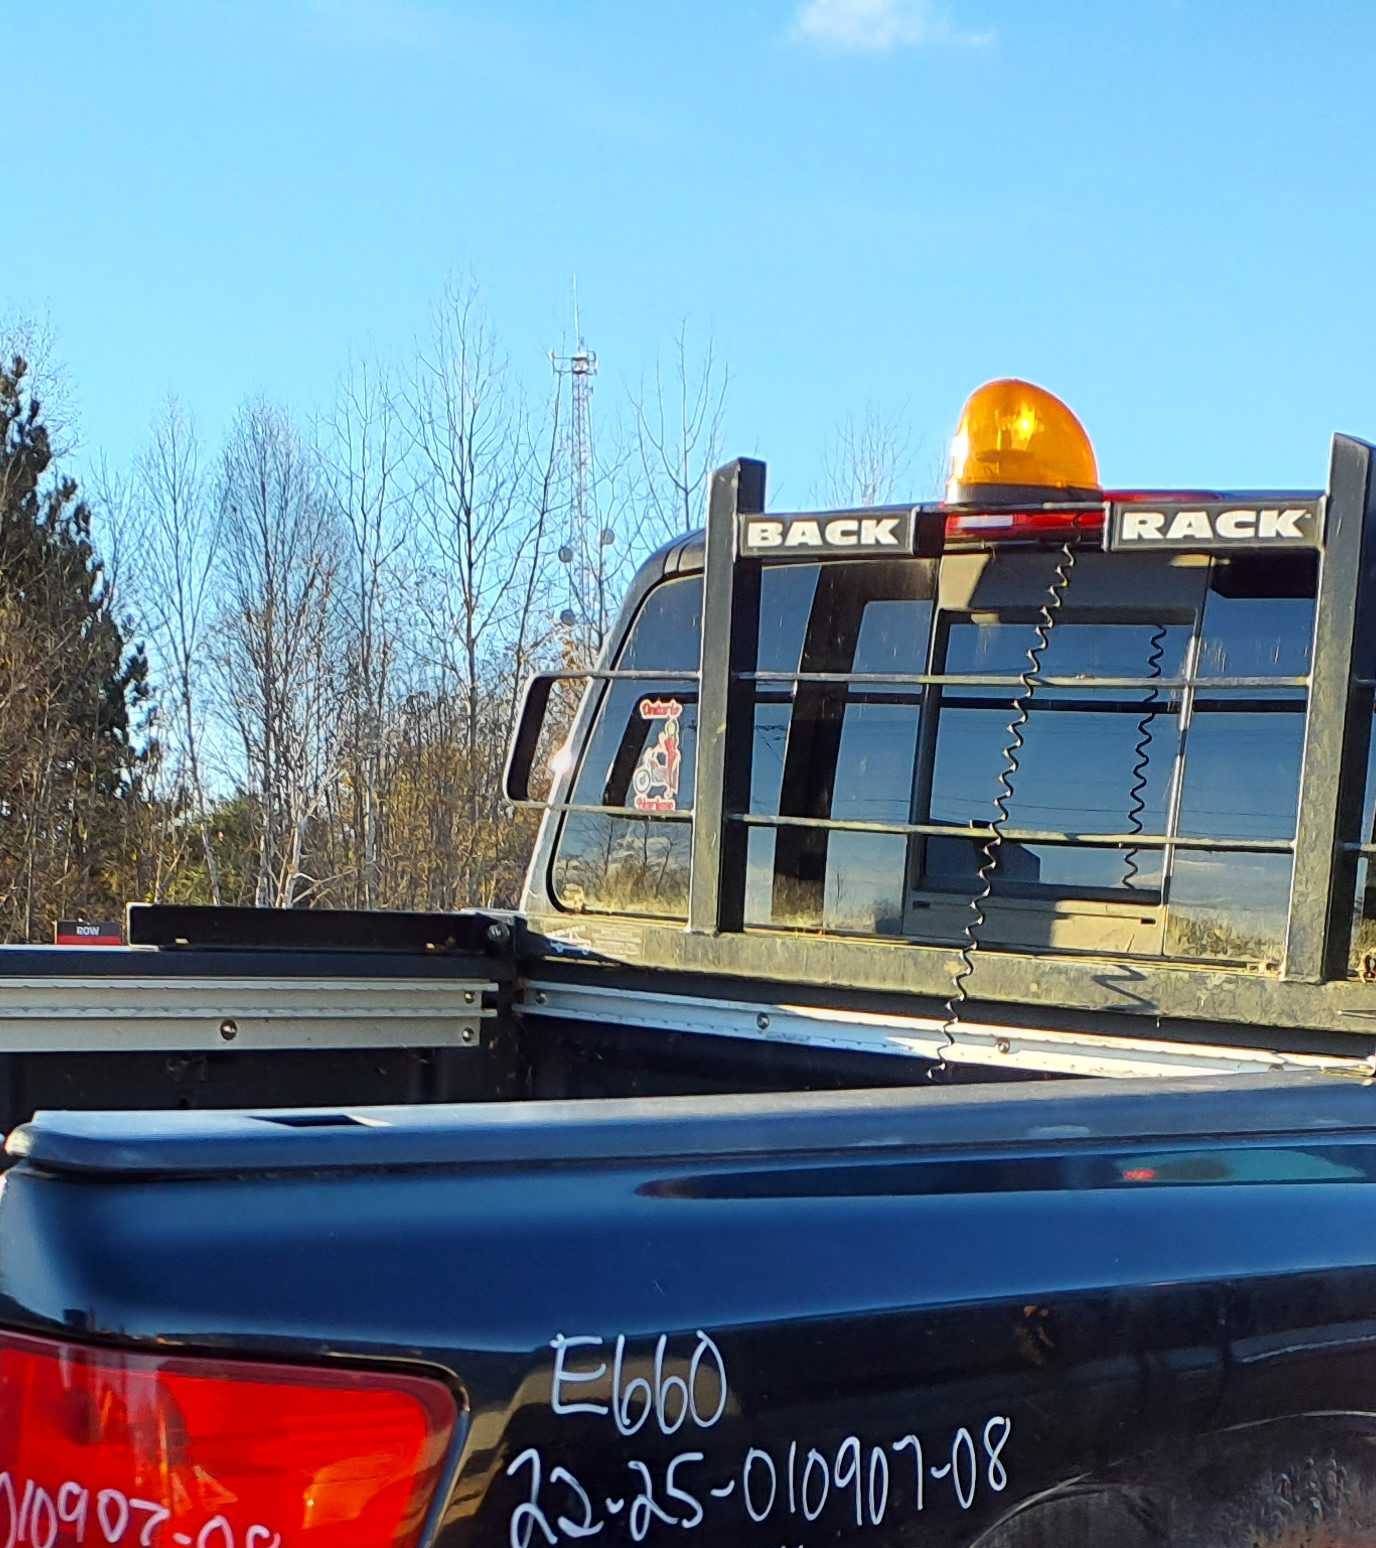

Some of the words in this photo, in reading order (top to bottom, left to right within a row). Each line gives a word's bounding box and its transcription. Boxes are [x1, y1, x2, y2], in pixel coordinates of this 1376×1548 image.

[747, 518, 901, 547] BACK
[1122, 509, 1308, 540] RACK
[550, 1331, 728, 1437] E660
